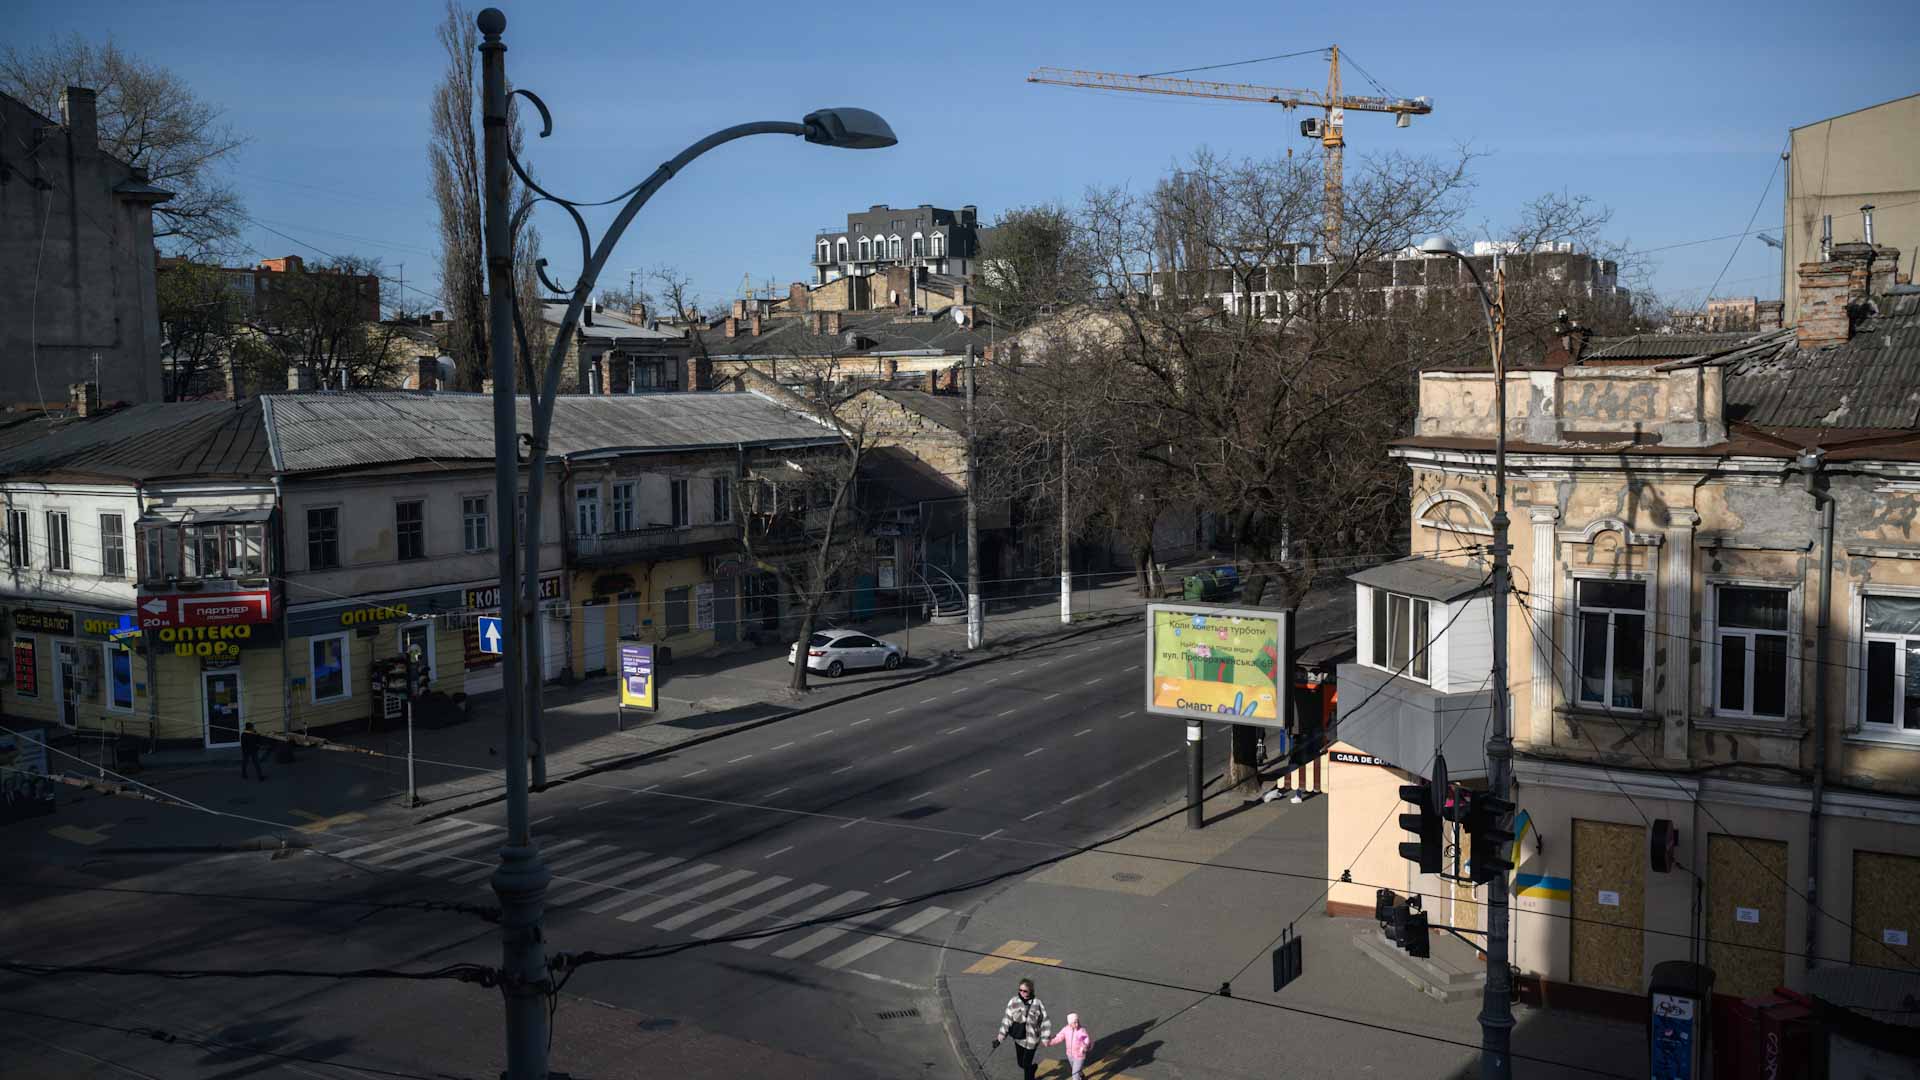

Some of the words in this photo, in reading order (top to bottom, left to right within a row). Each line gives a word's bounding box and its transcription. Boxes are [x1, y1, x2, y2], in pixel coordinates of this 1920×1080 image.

[196, 606, 249, 616] ПАРТНЕР
[143, 618, 160, 627] 20
[1169, 619, 1190, 629] Коли
[1230, 626, 1266, 636] турботи
[1176, 697, 1213, 712] Смарт
[1336, 753, 1359, 763] CASA
[1360, 756, 1373, 764] DE
